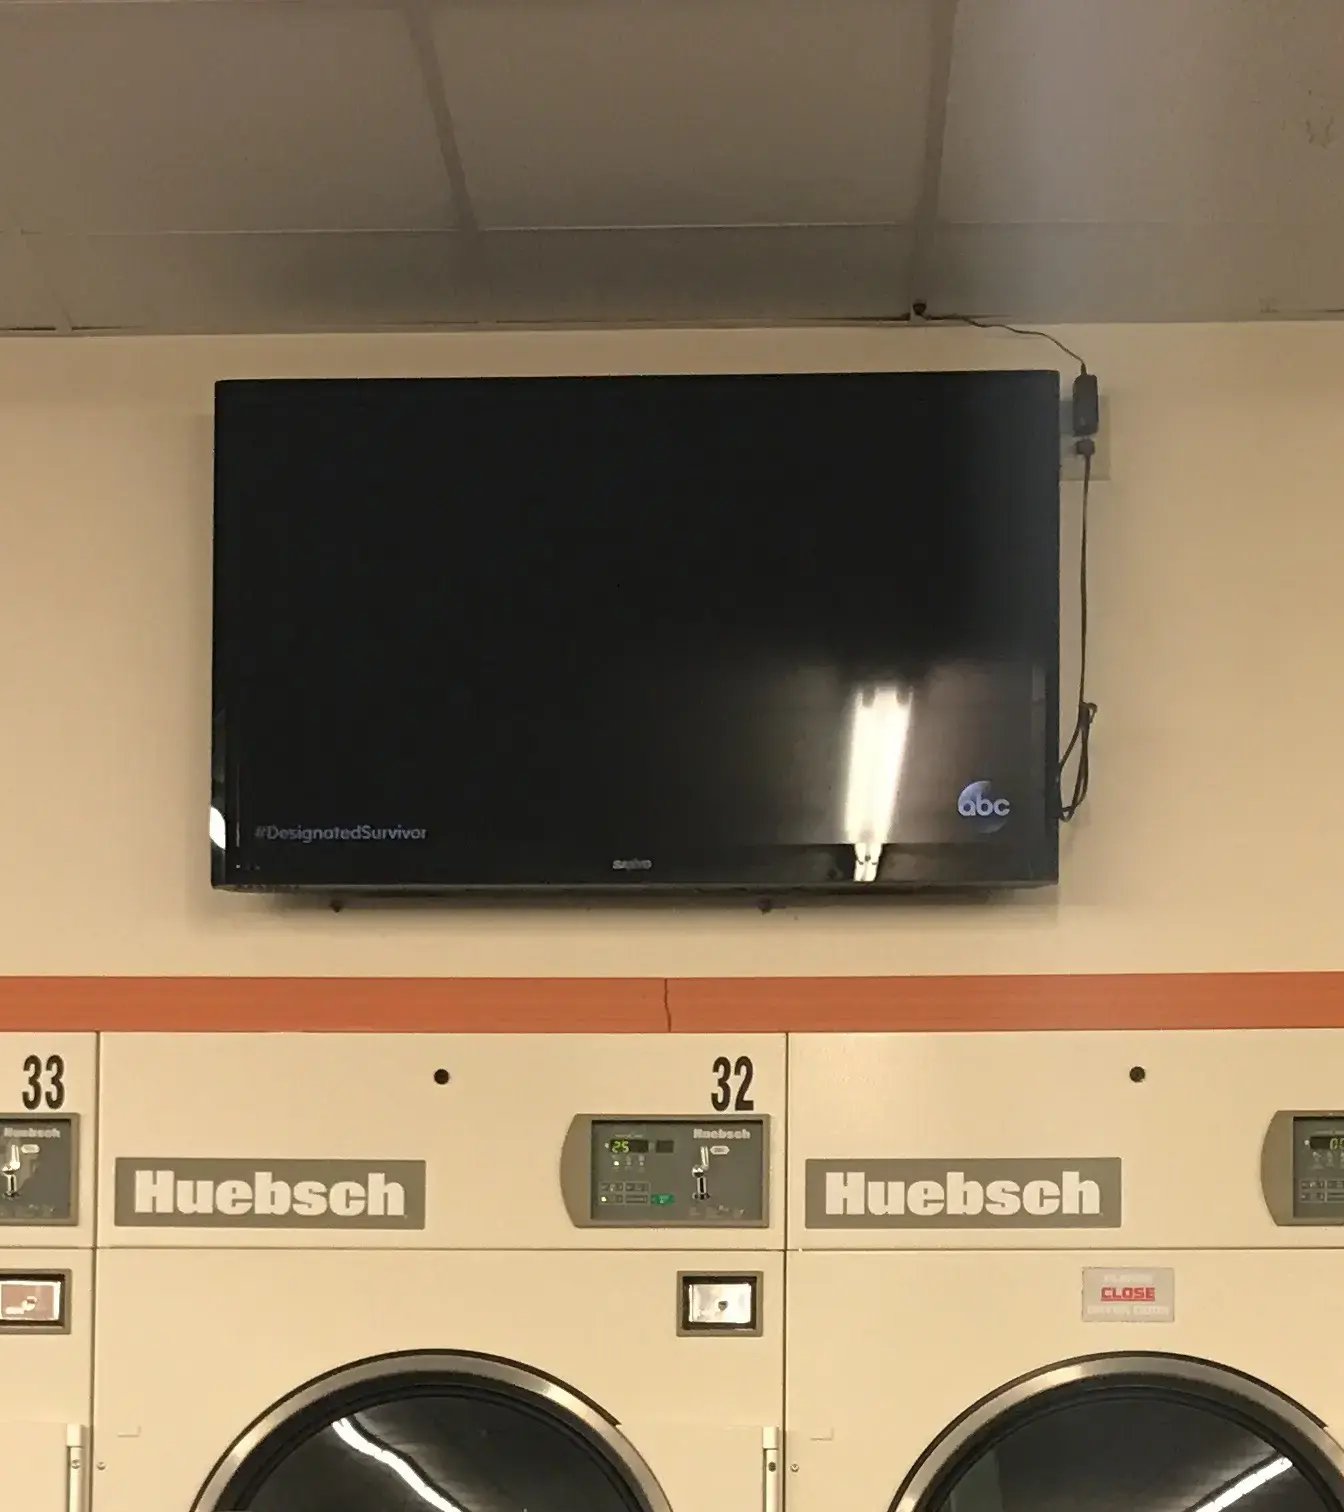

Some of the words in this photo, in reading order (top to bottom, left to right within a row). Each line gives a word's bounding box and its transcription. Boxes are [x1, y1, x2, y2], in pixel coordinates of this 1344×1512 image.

[957, 784, 1011, 817] abc
[256, 824, 427, 843] #DesignatedSurvivor
[22, 1054, 64, 1110] 33
[711, 1055, 754, 1112] 32
[134, 1170, 405, 1216] Huebsch
[825, 1170, 1100, 1216] Huebsch
[1101, 1287, 1155, 1301] CLOSE
